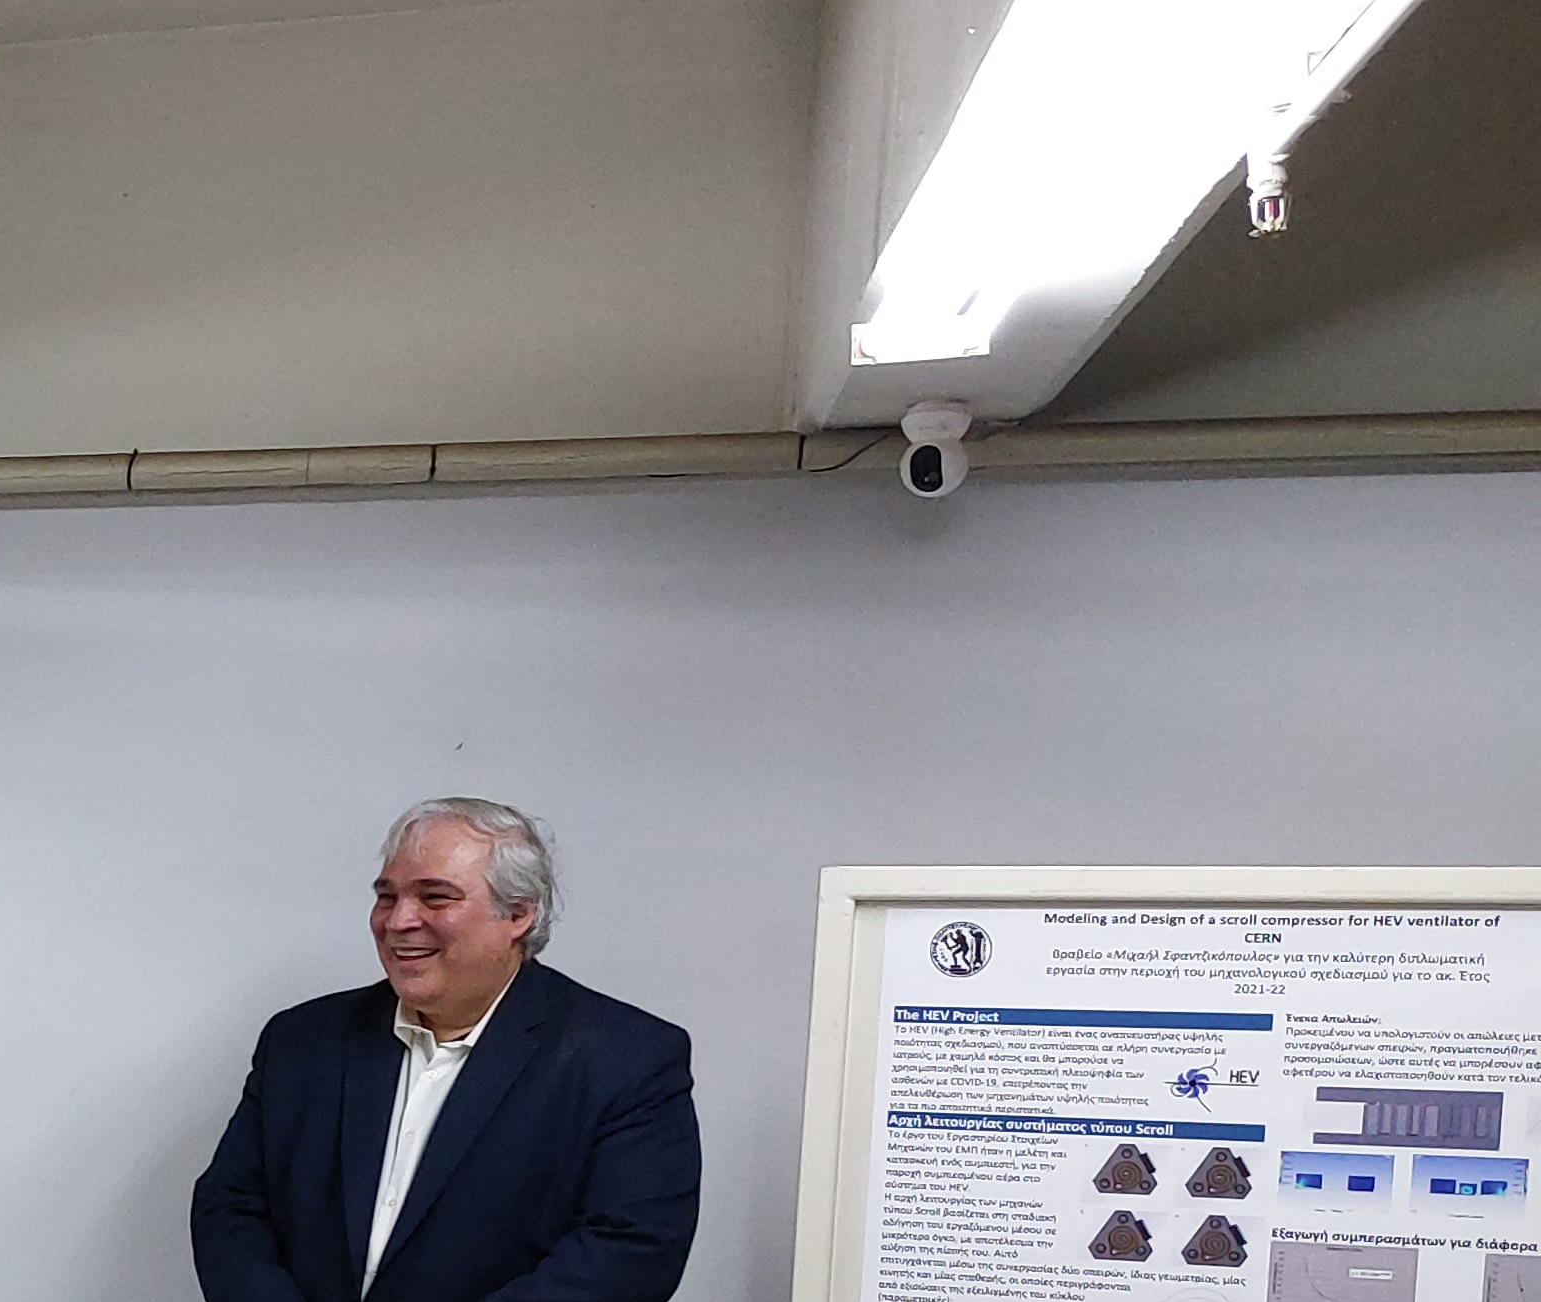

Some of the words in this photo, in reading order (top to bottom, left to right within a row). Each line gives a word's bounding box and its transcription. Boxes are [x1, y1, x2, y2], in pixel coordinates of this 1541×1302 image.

[1044, 913, 1108, 926] Modeling
[1111, 913, 1136, 924] and
[1140, 913, 1185, 926] Design
[1189, 913, 1204, 925] of
[1207, 916, 1216, 925] a
[1219, 914, 1258, 925] scroll
[1261, 917, 1344, 927] compressor
[1347, 914, 1372, 927] for
[1373, 915, 1404, 926] HEV
[1407, 915, 1481, 926] ventilator
[1484, 915, 1501, 927] of
[1244, 933, 1283, 943] CERN
[1046, 967, 1095, 977] εργασία
[1099, 967, 1128, 977] στην
[1130, 966, 1180, 979] περιοχή
[1184, 968, 1206, 977] του
[1208, 967, 1307, 979] μηχανολογικού
[1309, 968, 1391, 981] σχεδιασμού
[1392, 971, 1416, 982] για
[1416, 972, 1432, 981] το
[1435, 972, 1456, 981] ακ.
[1459, 970, 1491, 983] Έτος
[1234, 984, 1286, 995] 2021-22
[896, 1009, 919, 1020] The
[923, 1010, 950, 1021] HEV
[953, 1011, 1000, 1023] Project
[1229, 1070, 1260, 1083] HEV
[888, 1115, 921, 1129] Αρχή
[924, 1116, 1003, 1131] λειτουργίας
[1006, 1119, 1087, 1134] συστήματος
[1090, 1121, 1132, 1135] τύπου
[1136, 1124, 1174, 1136] Scroll
[1271, 1228, 1328, 1242] Εξαγωγή
[1332, 1233, 1446, 1248] συμπερασμάτων
[1449, 1240, 1472, 1250] για
[1475, 1239, 1539, 1254] διάφορα
